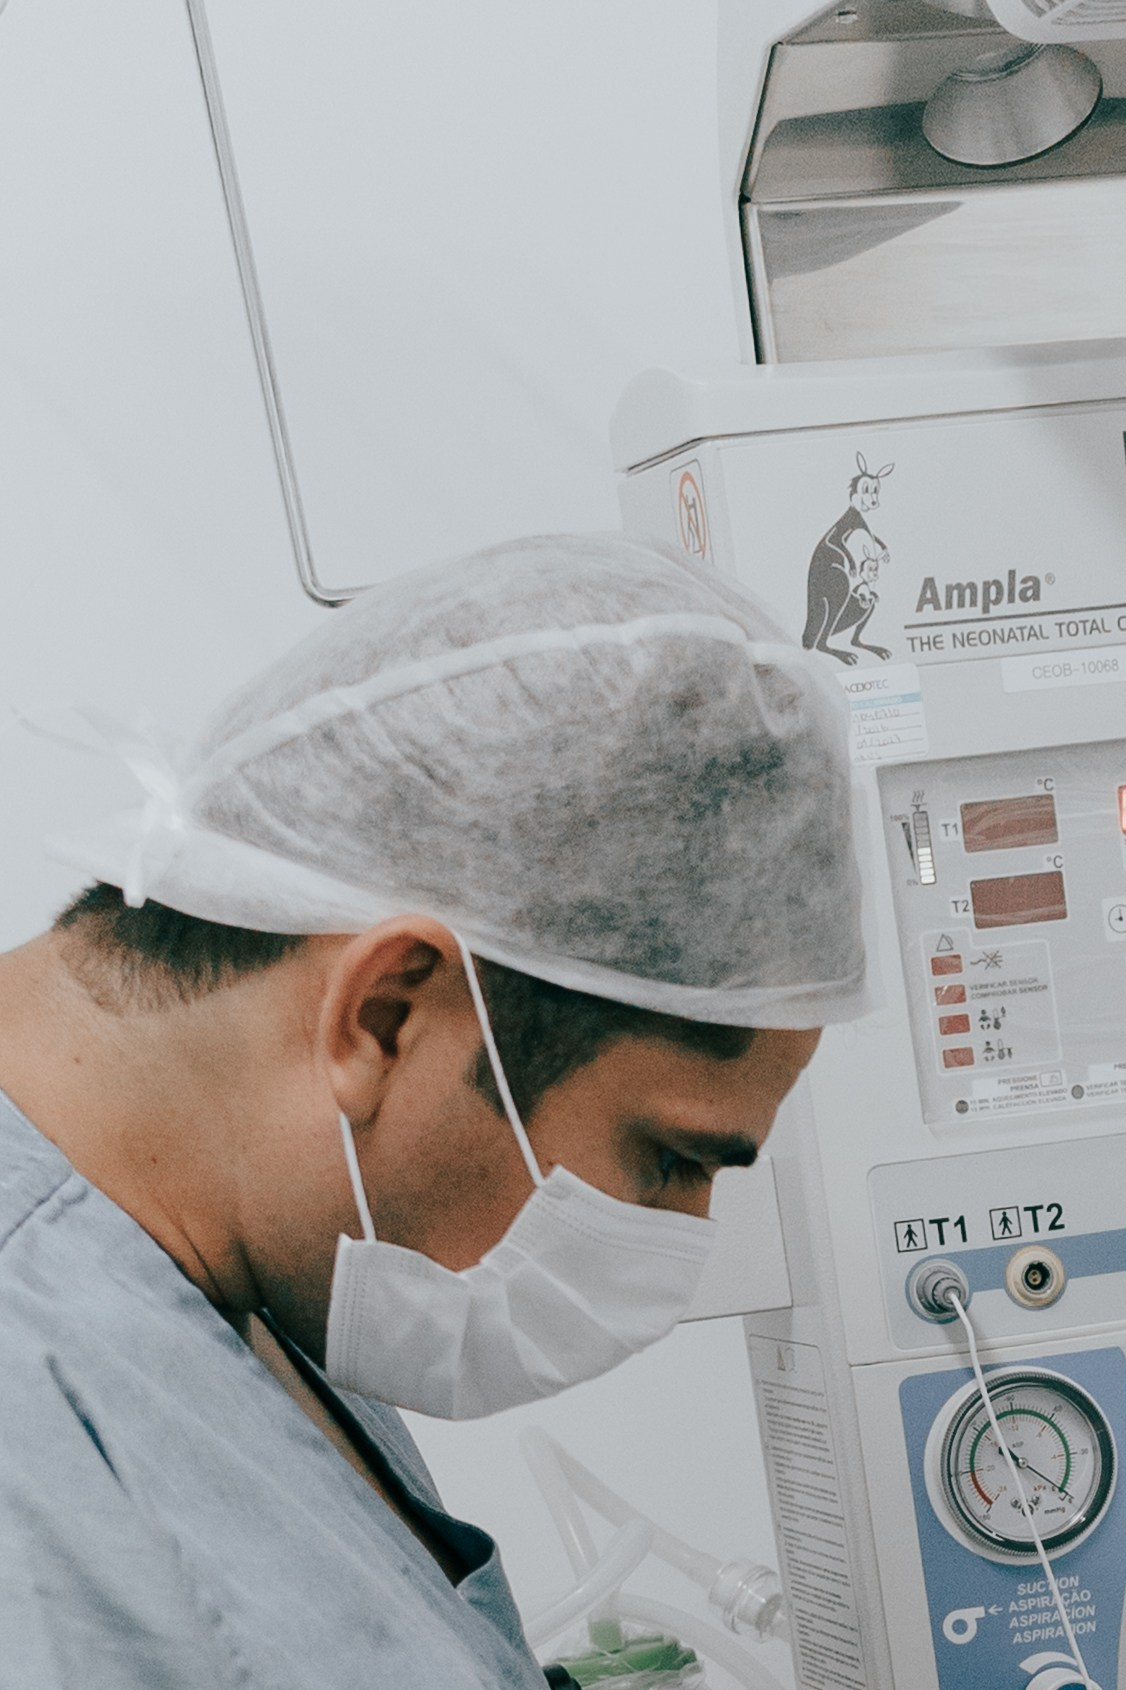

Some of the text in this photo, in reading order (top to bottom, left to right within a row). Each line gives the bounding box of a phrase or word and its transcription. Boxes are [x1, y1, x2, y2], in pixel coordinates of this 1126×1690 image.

[907, 633, 945, 653] THE
[952, 624, 1049, 649] NEONATAL
[1054, 618, 1111, 639] TOTAL
[1032, 659, 1119, 680] CEOB-10068
[942, 823, 959, 836] T1
[952, 900, 970, 913] T2
[970, 980, 1007, 991] VERIFICAR
[1019, 984, 1048, 994] SENSOR
[998, 1074, 1038, 1085] PRESSIONE
[1010, 1083, 1040, 1092] PRENSA
[929, 1203, 1066, 1246] T1 T2
